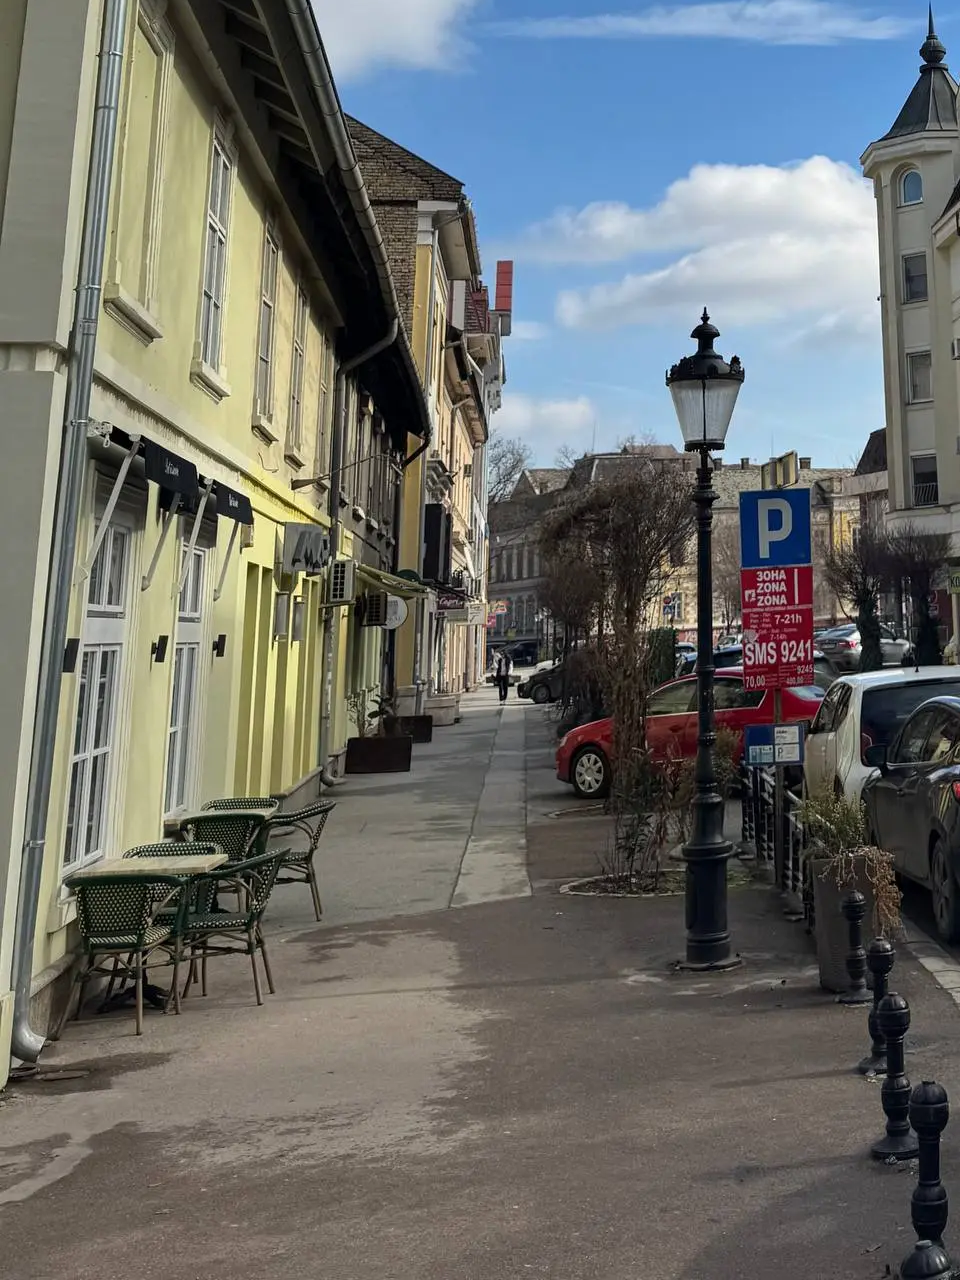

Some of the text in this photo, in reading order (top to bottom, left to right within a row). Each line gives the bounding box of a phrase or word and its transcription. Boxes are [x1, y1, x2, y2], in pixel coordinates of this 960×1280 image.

[757, 497, 793, 559] P
[756, 581, 787, 593] ZONA
[774, 613, 802, 625] 7-21h
[745, 639, 812, 665] SMS 9241
